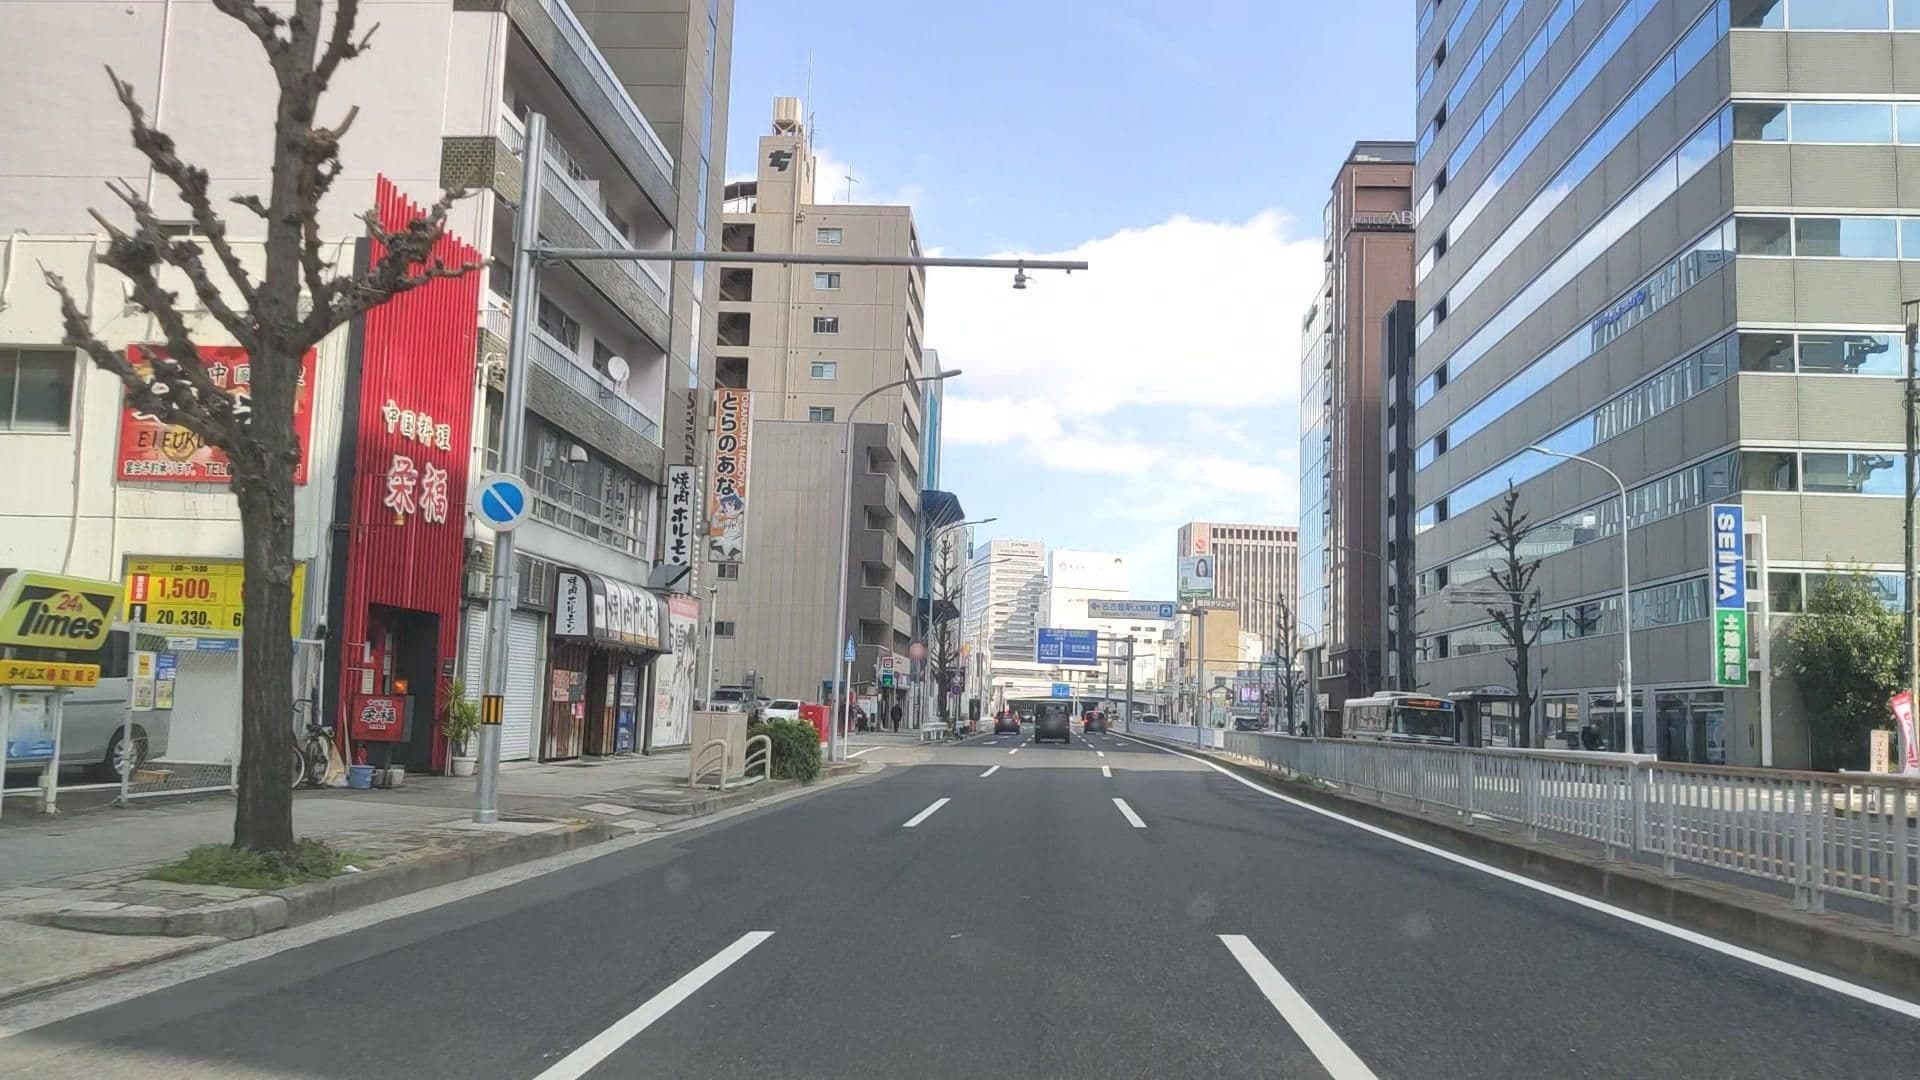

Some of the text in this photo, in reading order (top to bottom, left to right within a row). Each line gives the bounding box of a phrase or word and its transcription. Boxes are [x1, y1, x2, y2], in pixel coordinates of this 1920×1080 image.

[382, 399, 451, 451] 中国料理
[716, 391, 738, 496] とらのあな
[384, 454, 448, 524] 栄福
[737, 449, 747, 489] NAGOYA
[671, 471, 690, 567] 焼肉ホルモン
[1717, 512, 1741, 601] SEIWA
[17, 601, 103, 639] Times
